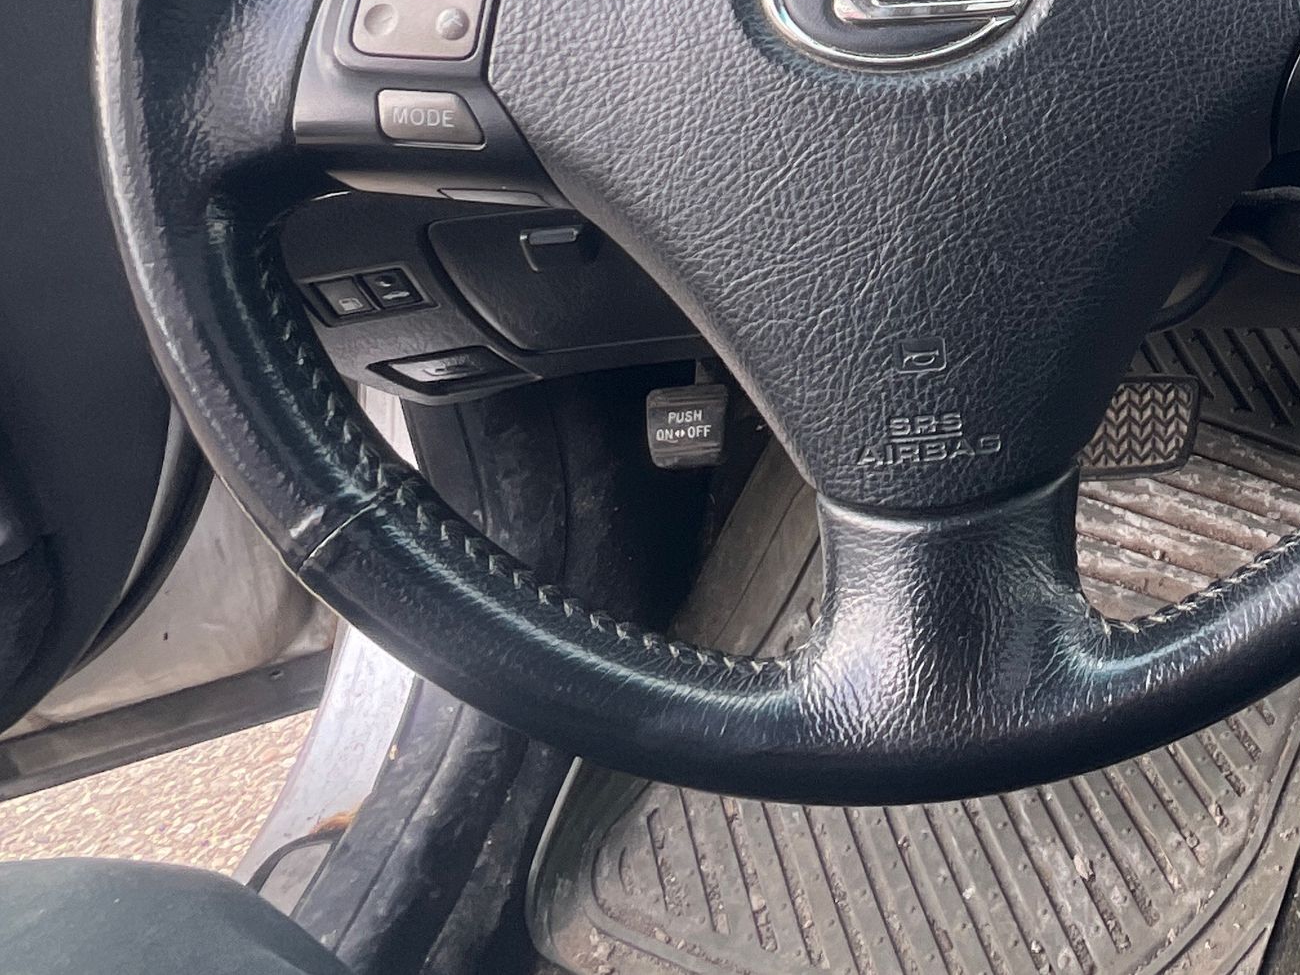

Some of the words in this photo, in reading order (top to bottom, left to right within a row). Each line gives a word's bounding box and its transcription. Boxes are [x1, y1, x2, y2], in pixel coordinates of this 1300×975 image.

[392, 106, 455, 128] MODE
[668, 409, 703, 424] PUSH
[889, 412, 963, 436] SRS
[656, 428, 674, 442] ON
[687, 425, 712, 439] OFF
[857, 433, 1001, 466] AIRBAG
